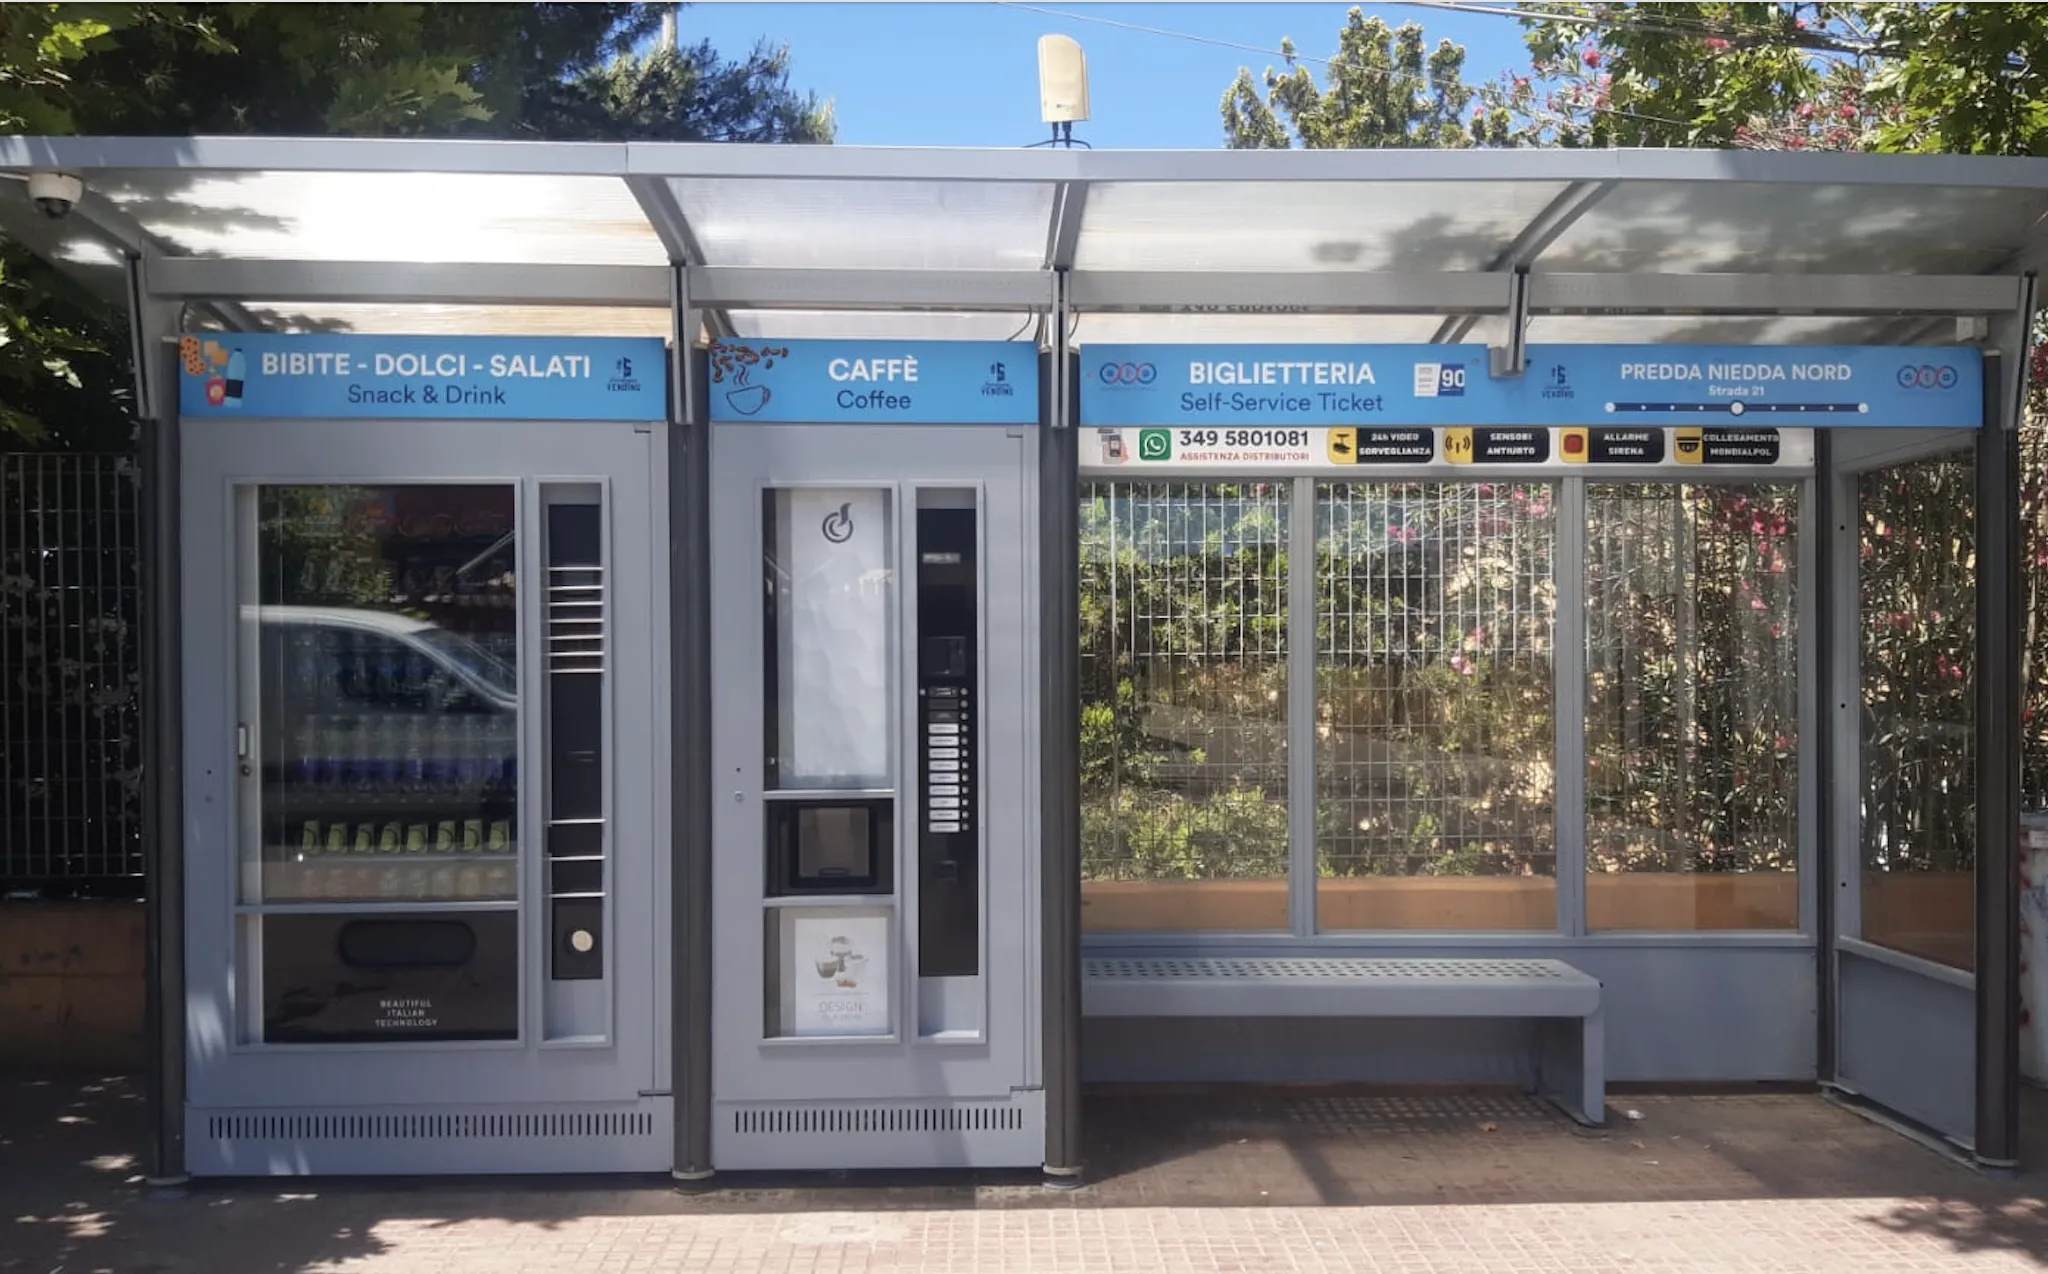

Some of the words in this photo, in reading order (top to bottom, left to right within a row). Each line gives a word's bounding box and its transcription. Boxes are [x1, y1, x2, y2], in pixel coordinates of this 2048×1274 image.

[262, 353, 350, 376] BIBITE
[375, 353, 465, 377] DOLCI
[490, 354, 590, 378] SALATI
[828, 355, 918, 382] CAFFÈ
[1190, 362, 1375, 385] BIGLIETTERIA
[1621, 364, 1702, 380] PREDDA
[1709, 364, 1785, 380] NIEDDA
[1792, 364, 1851, 380] NORD
[1441, 369, 1465, 387] 90
[347, 385, 415, 404] Snack
[423, 385, 438, 404] &
[446, 384, 506, 405] Drink
[1709, 385, 1748, 396] Strada
[1752, 386, 1764, 396] 21
[836, 390, 912, 410] Coffee
[1180, 392, 1311, 412] Self-Service
[1318, 392, 1383, 412] Ticket
[1180, 430, 1218, 446] 349
[1225, 430, 1308, 446] 5801081
[1390, 433, 1419, 441] VIDEO
[1490, 433, 1532, 441] SENSORI
[1604, 433, 1649, 441] ALLARME
[1180, 452, 1240, 461] ASSISTENZA
[1243, 452, 1309, 461] DISTRIBUTORI
[1359, 447, 1431, 456] SORVEGLIANZA
[1608, 447, 1644, 455] SIRENA
[1710, 447, 1772, 456] MONDIALPOL
[380, 1000, 432, 1008] BEAUTIFUL
[375, 1019, 438, 1027] TECHNOLOGY
